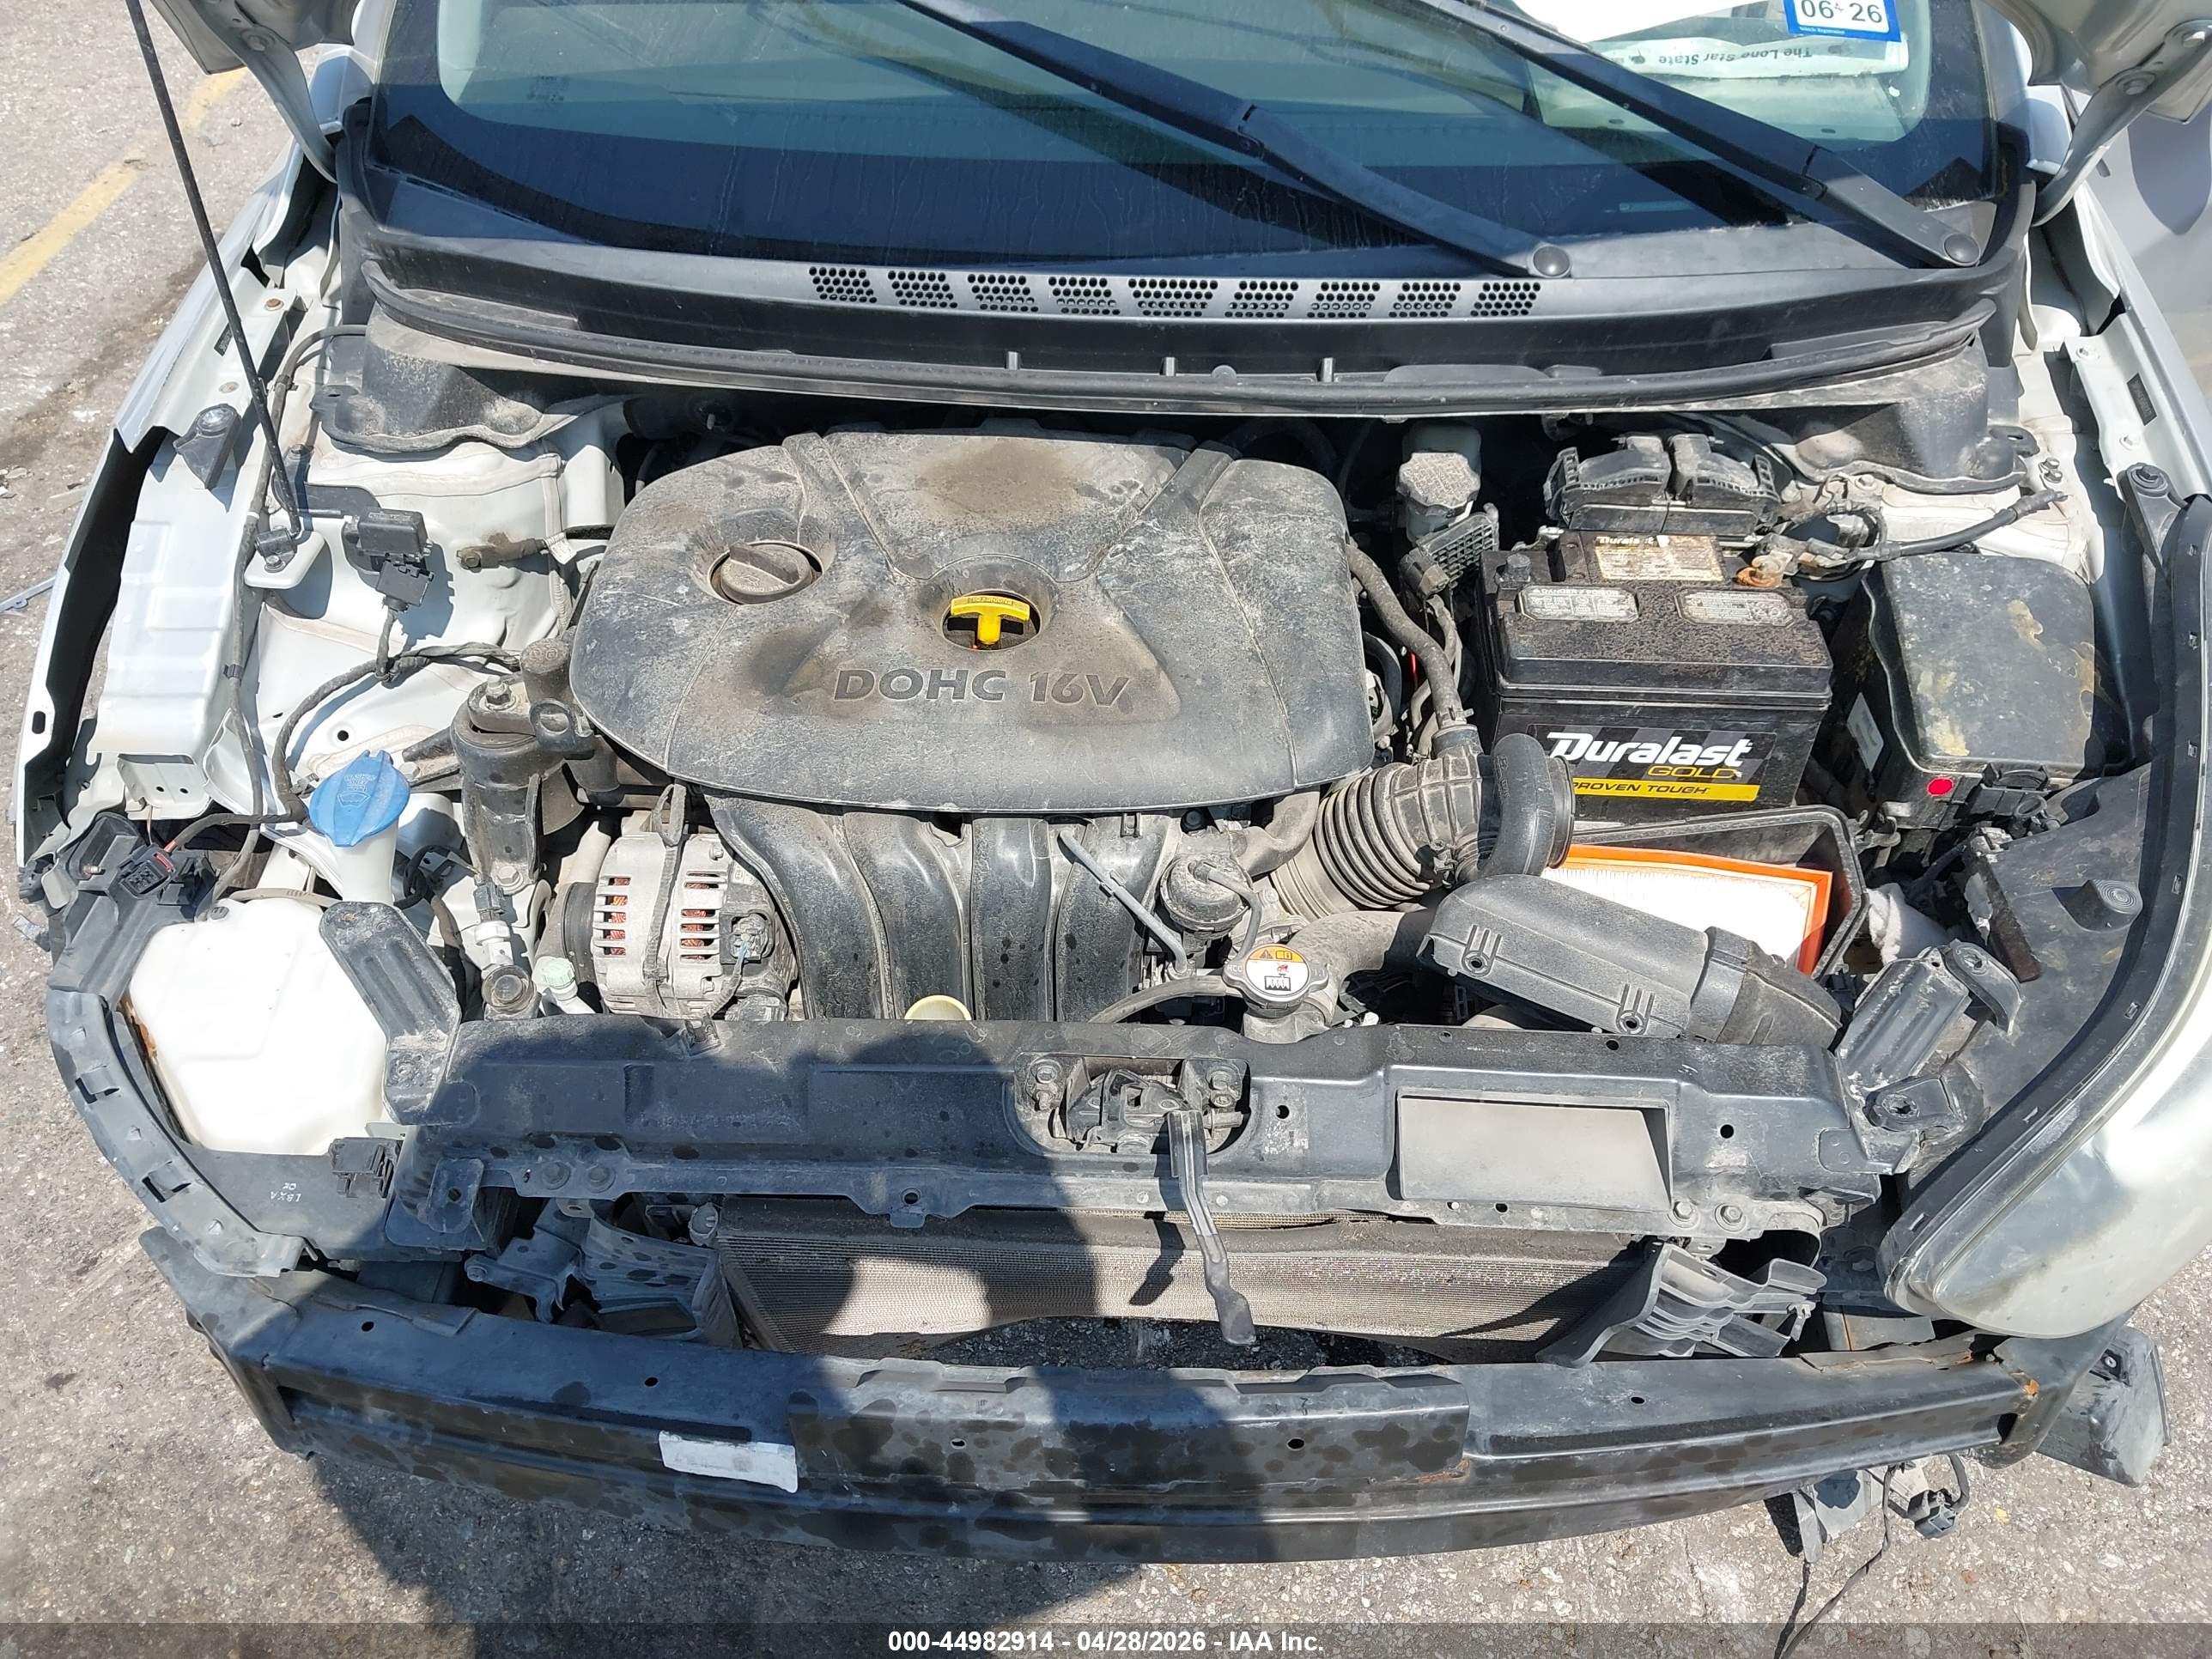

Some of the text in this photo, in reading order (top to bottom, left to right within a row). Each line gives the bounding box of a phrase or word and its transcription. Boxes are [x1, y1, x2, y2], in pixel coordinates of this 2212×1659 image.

[1801, 0, 1882, 23] 06 26
[1658, 47, 1813, 66] The Lone Star State
[834, 668, 1130, 708] DOHC 16V
[1546, 732, 1753, 767] Duralast
[1647, 765, 1737, 779] GOLD
[1648, 785, 1707, 794] TOUGH
